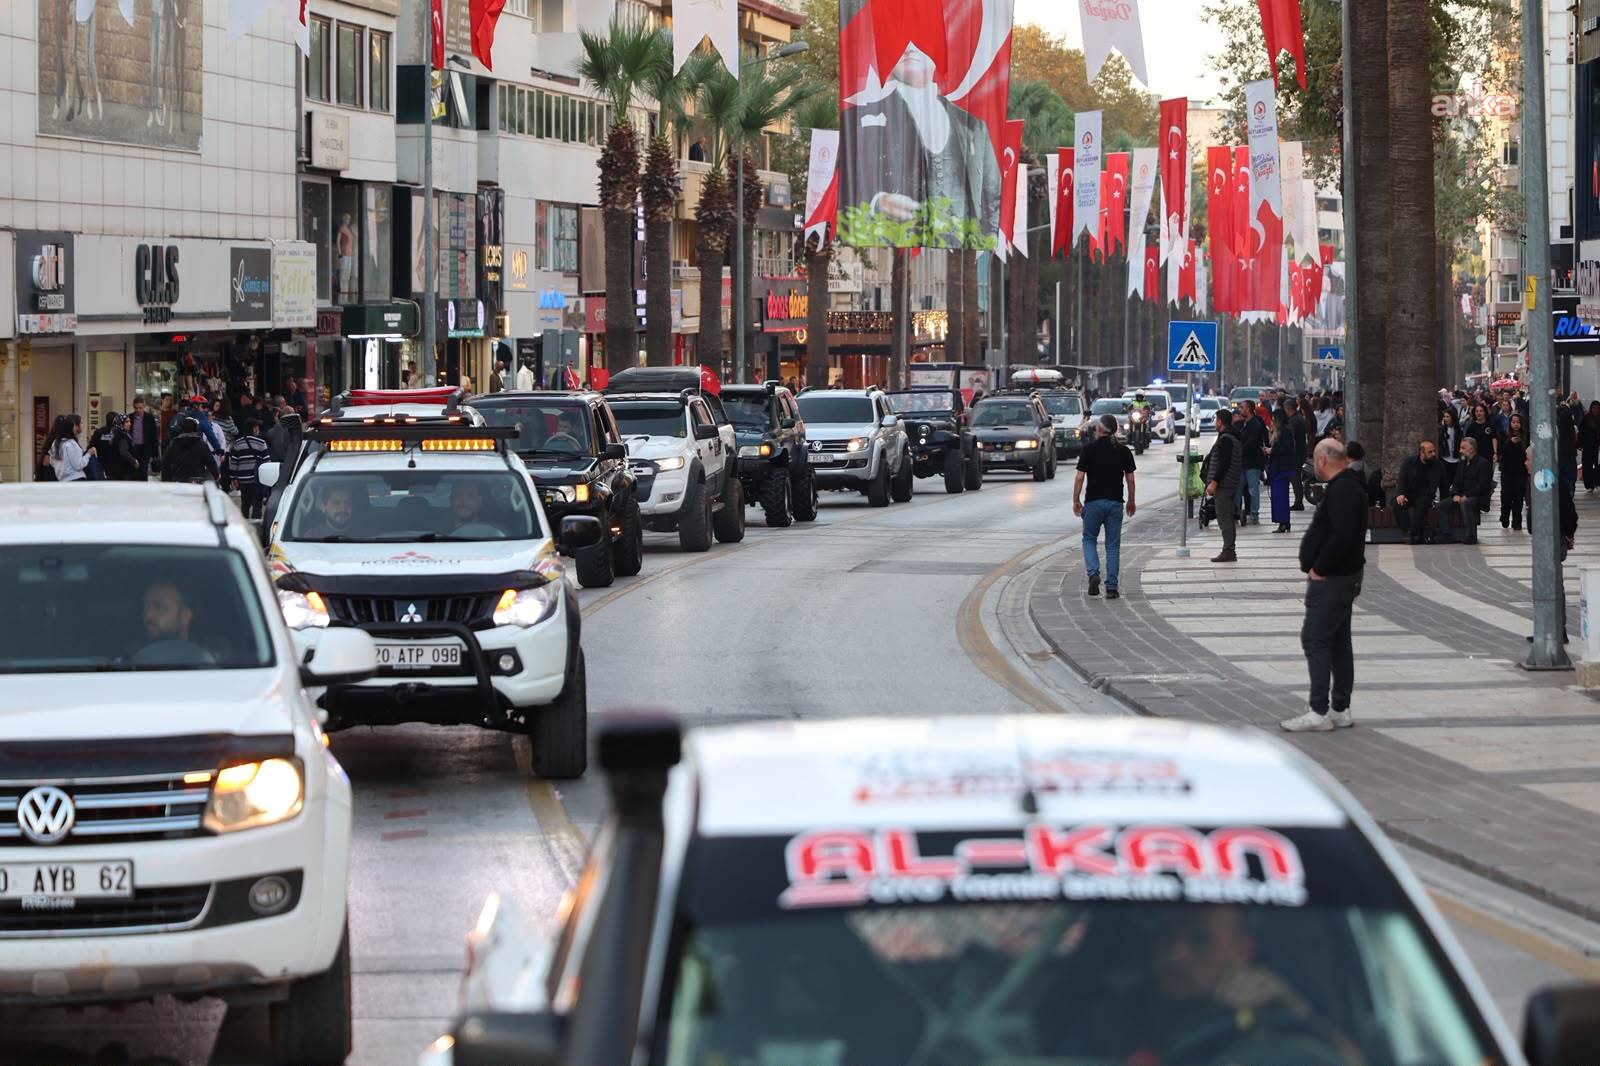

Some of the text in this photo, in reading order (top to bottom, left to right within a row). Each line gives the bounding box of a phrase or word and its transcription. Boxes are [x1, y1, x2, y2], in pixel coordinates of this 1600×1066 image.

[398, 647, 424, 663] ATP
[432, 647, 459, 663] 098
[34, 866, 76, 892] AYB
[99, 864, 128, 891] 62
